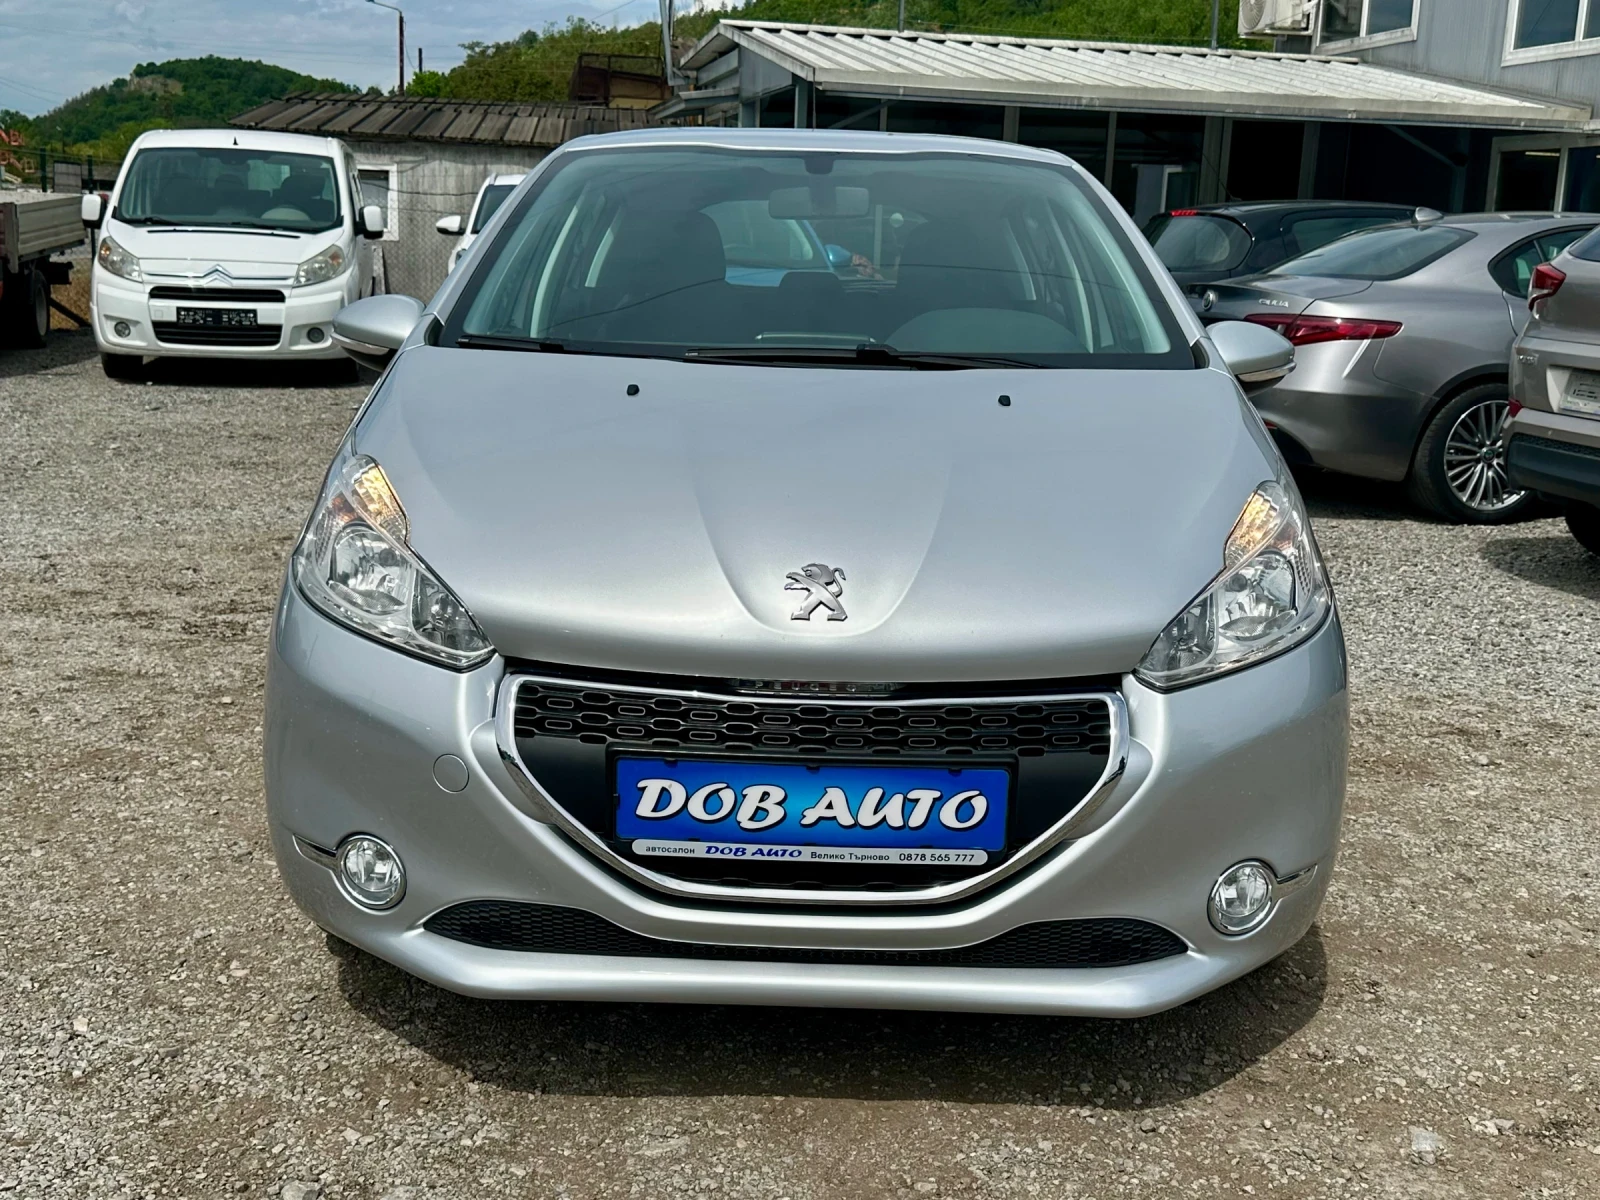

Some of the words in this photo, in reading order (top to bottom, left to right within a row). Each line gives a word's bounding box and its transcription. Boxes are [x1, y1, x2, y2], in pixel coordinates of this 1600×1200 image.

[634, 778, 787, 830] DOB
[799, 786, 989, 830] AUTO
[645, 845, 695, 855] автосалон
[705, 845, 747, 857] DOB
[750, 847, 802, 858] AUTO
[810, 851, 846, 860] Велико
[849, 852, 890, 862] Търново
[898, 853, 927, 862] 0878
[929, 853, 951, 862] 565
[954, 853, 975, 862] 777
